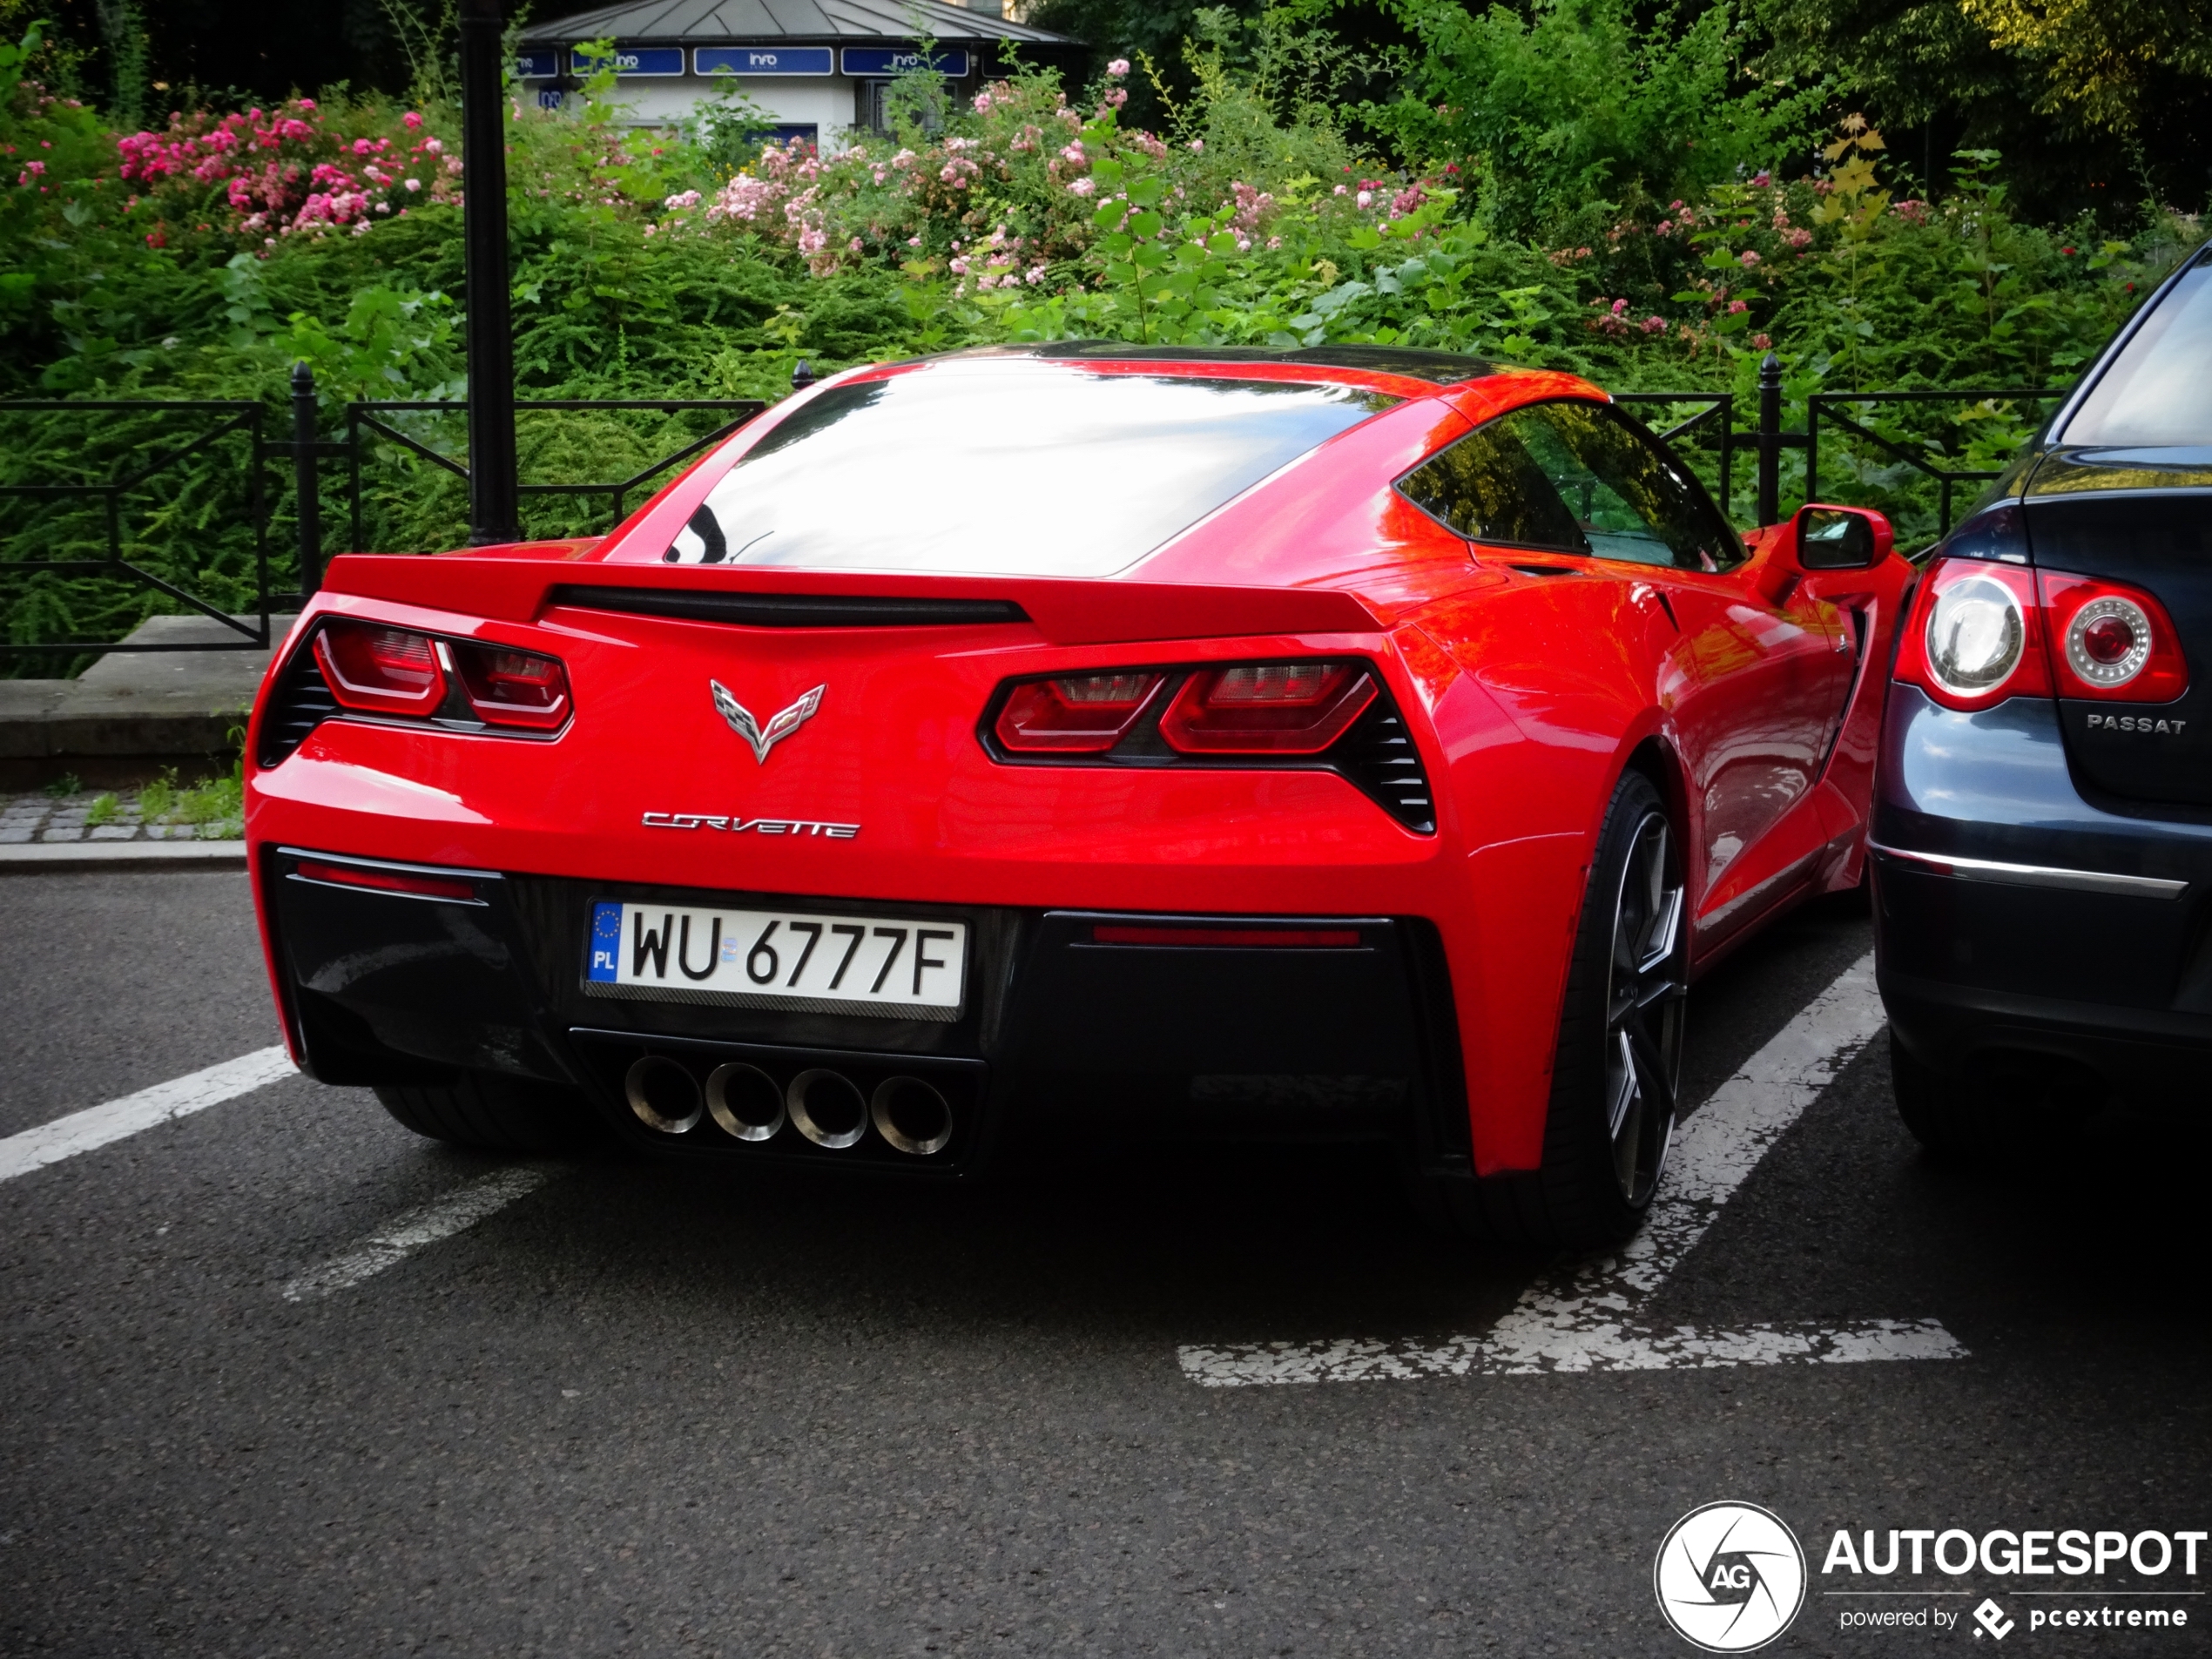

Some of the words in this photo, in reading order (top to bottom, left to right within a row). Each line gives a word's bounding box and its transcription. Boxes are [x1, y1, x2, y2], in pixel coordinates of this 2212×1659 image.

[2087, 714, 2187, 735] PASSAT
[641, 811, 861, 838] CORVETTE
[593, 950, 615, 970] PL
[632, 911, 722, 981] WU
[745, 920, 954, 996] 6777F
